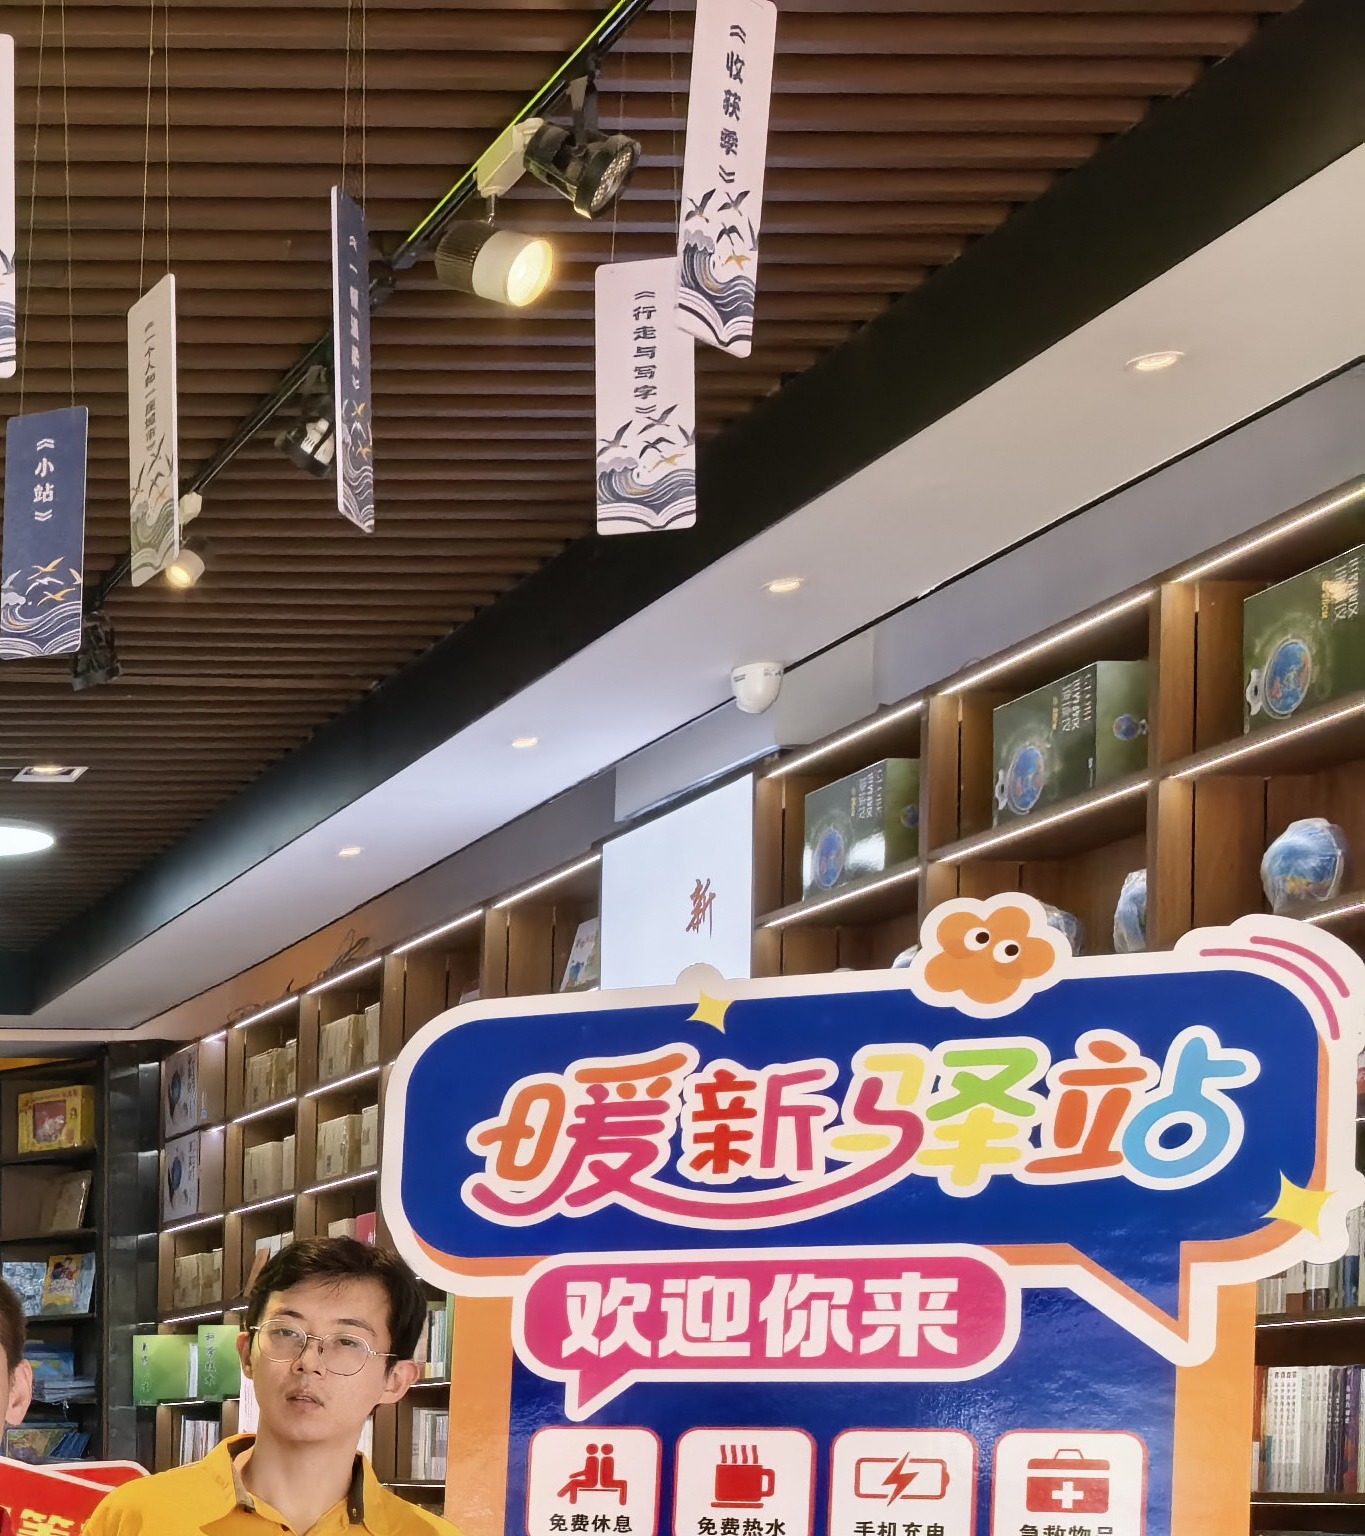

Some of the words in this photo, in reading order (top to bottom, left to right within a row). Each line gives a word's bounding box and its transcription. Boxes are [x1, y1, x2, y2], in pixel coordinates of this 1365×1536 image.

[632, 289, 658, 418] 《行走与写字》
[33, 437, 55, 522] 《小站》
[686, 877, 718, 940] 新
[470, 1034, 1249, 1222] 暖新驿站
[561, 1273, 959, 1360] 欢迎你来
[548, 1511, 633, 1535] 免费休息
